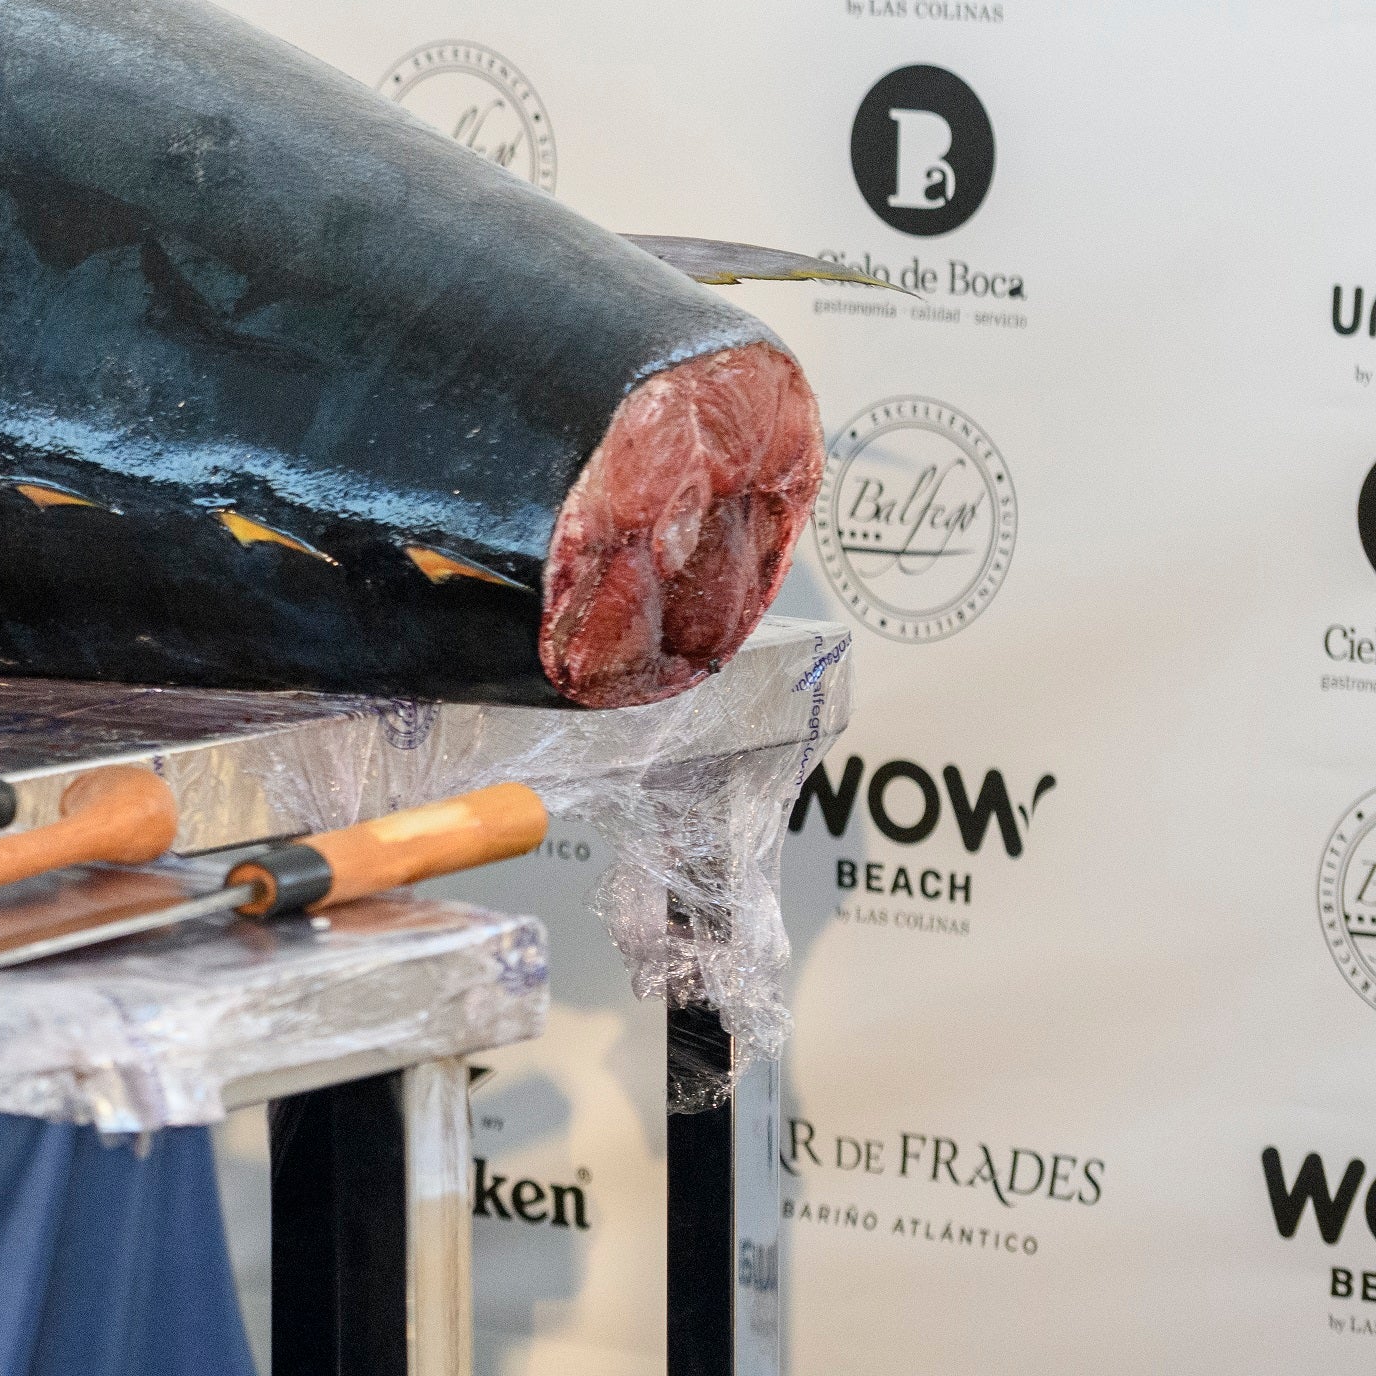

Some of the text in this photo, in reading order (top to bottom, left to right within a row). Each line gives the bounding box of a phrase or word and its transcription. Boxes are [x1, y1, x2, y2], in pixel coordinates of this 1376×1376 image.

[914, 0, 1005, 25] COLINAS
[900, 255, 939, 295] de
[949, 258, 1028, 303] Boca
[1323, 622, 1376, 665] Cie
[835, 858, 972, 906] BEACH
[855, 906, 889, 925] LAS
[894, 910, 970, 937] COLINAS
[471, 1155, 590, 1231] ken
[835, 1135, 886, 1175] DE
[899, 1130, 1106, 1209] FRADES
[1260, 1143, 1376, 1245] W
[781, 1198, 1040, 1258] BARIÑO ATLÁNTICO
[1349, 1314, 1376, 1336] LA
